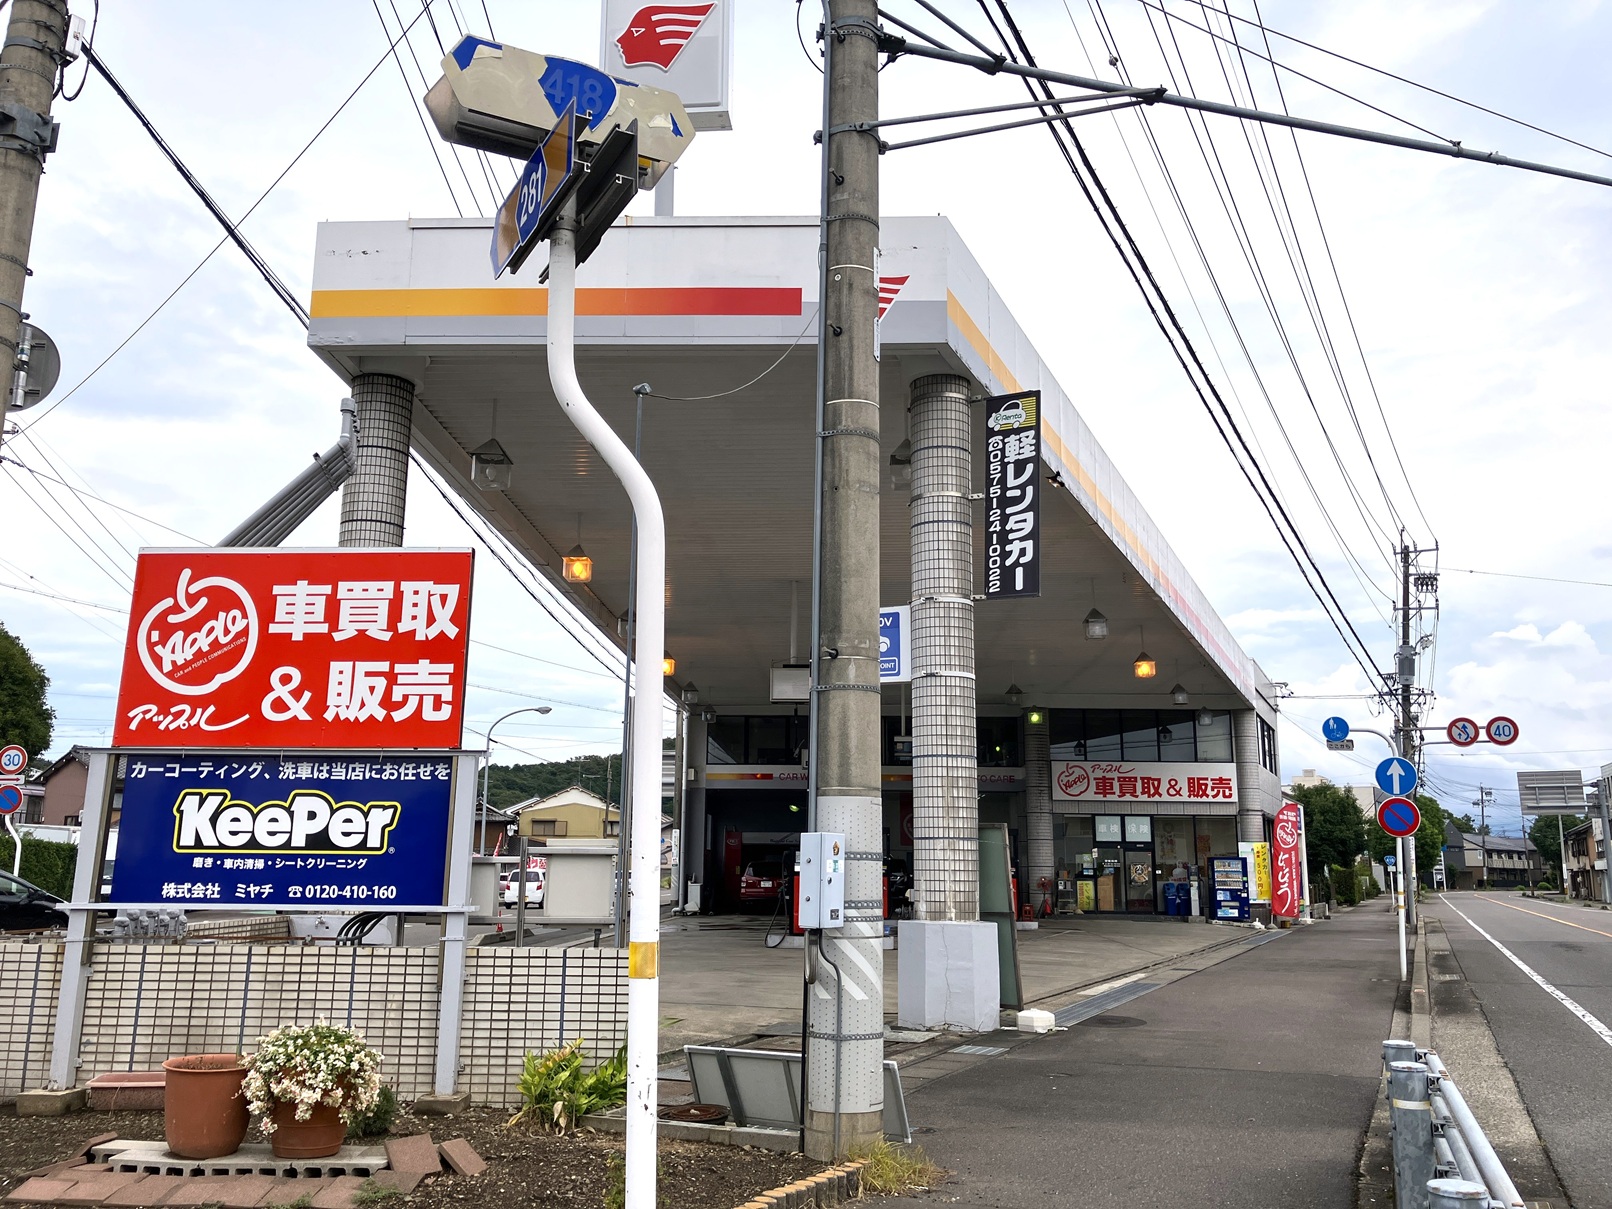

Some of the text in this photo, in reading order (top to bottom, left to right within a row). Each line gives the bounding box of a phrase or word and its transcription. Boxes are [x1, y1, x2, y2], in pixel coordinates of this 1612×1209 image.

[543, 69, 603, 115] 418
[520, 162, 543, 228] 281
[1004, 430, 1036, 591] 軽レンタカー
[989, 450, 1002, 593] 0575-24-0022
[268, 580, 460, 642] 車買取
[174, 670, 184, 678] CAR
[192, 657, 208, 669] PEOPLE
[207, 636, 247, 660] COMMUNICATIONS
[127, 703, 250, 731] アップル
[1493, 724, 1511, 737] 40
[4, 753, 21, 767] 30
[130, 761, 451, 781] カーコーティング、洗車は当店にお任せを
[779, 772, 799, 781] CAR
[990, 774, 1015, 783] CARE
[177, 793, 395, 849] KeePer
[1098, 823, 1119, 833] 車検
[1128, 823, 1149, 834] 保険
[193, 857, 367, 870] 磨き・車内清掃・シートクリーニング
[161, 882, 397, 900] 株式会社 ミヤチ 0120-410-160
